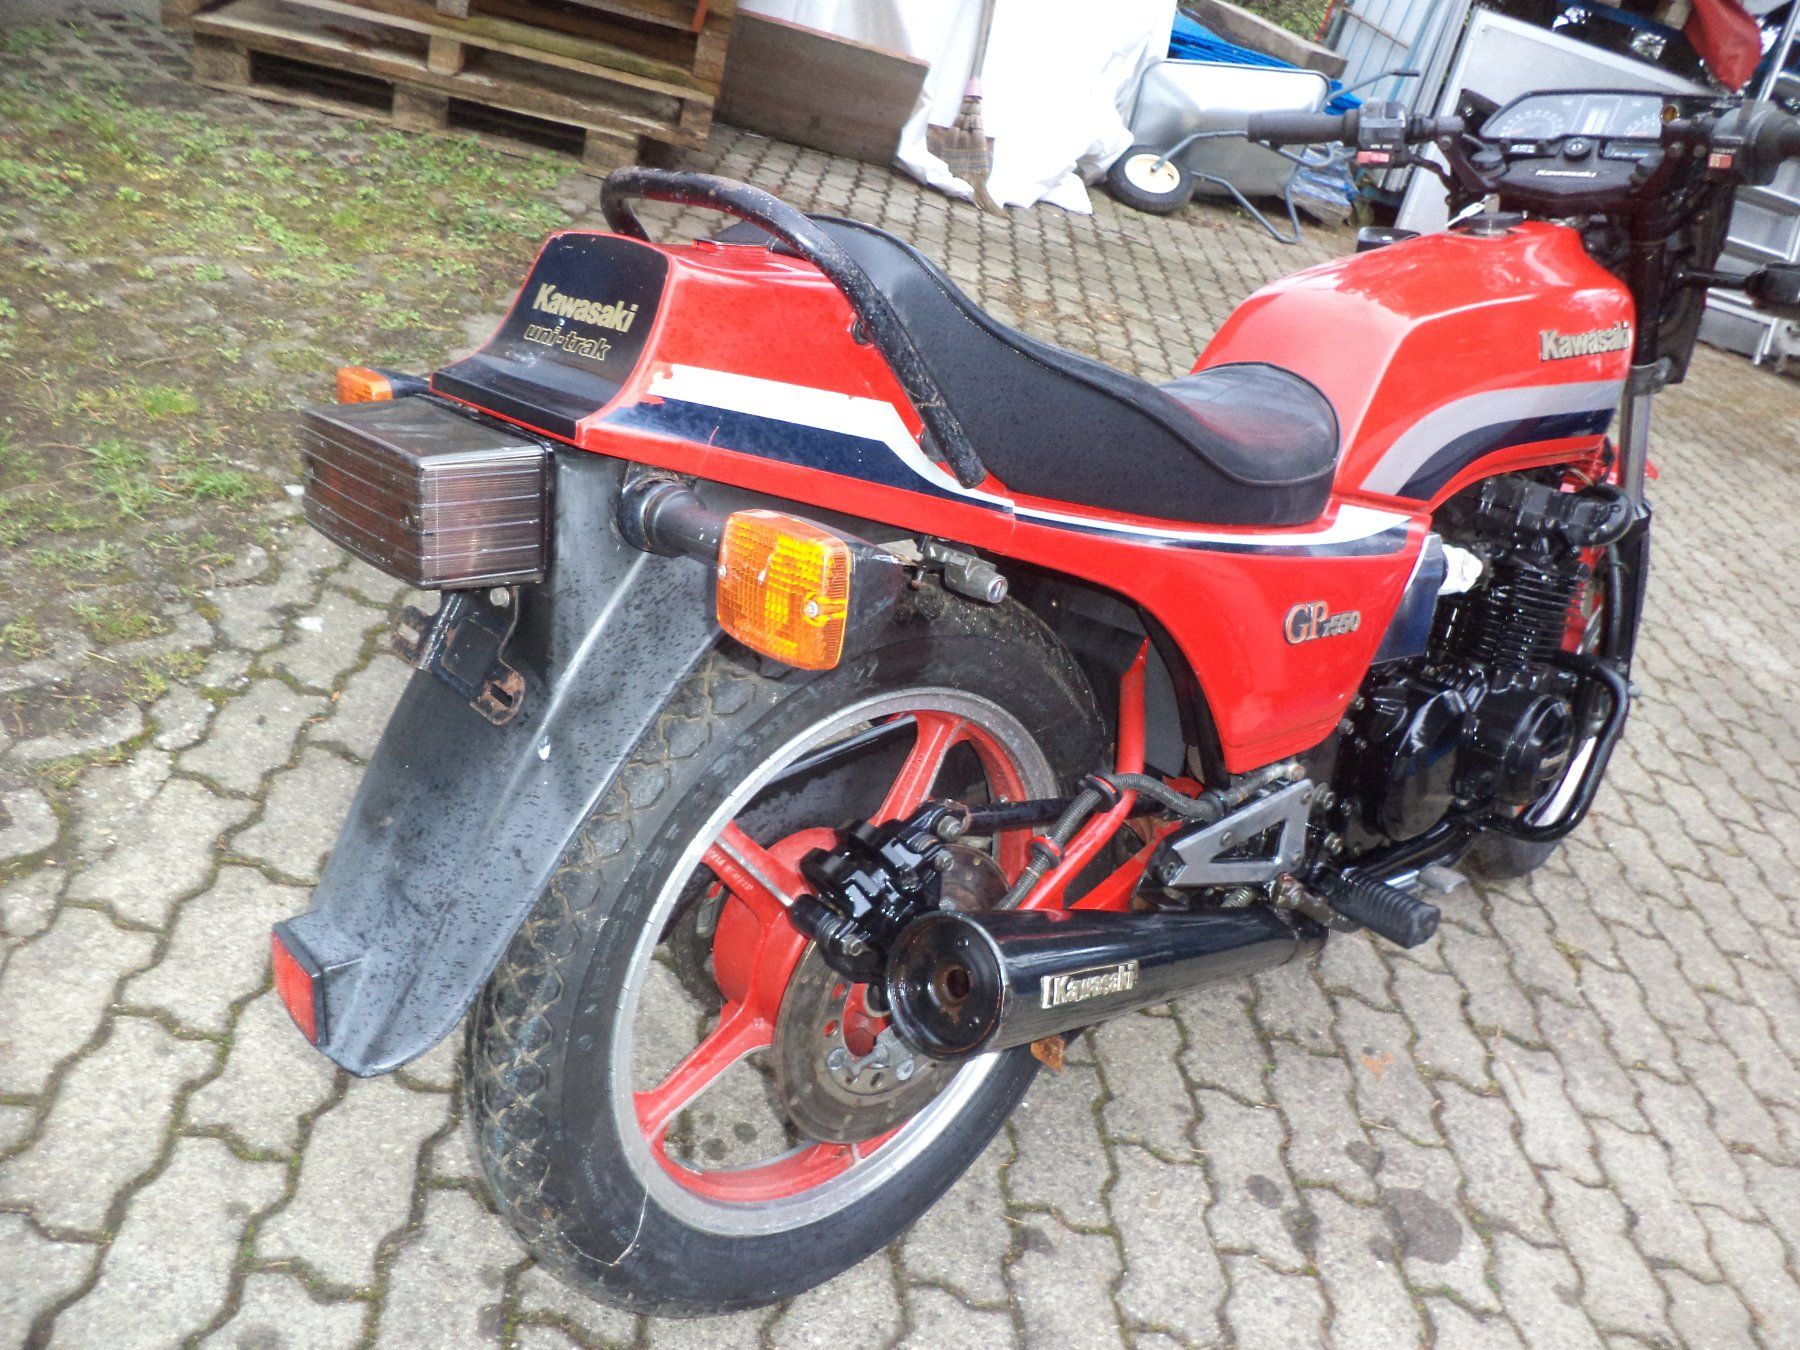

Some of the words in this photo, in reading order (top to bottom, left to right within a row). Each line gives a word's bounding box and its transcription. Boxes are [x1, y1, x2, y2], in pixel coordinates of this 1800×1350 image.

[532, 283, 639, 332] Kawasaki
[523, 324, 612, 361] uni-trak
[1539, 320, 1633, 361] Kawasaki
[1051, 962, 1135, 1006] Kawasaki
